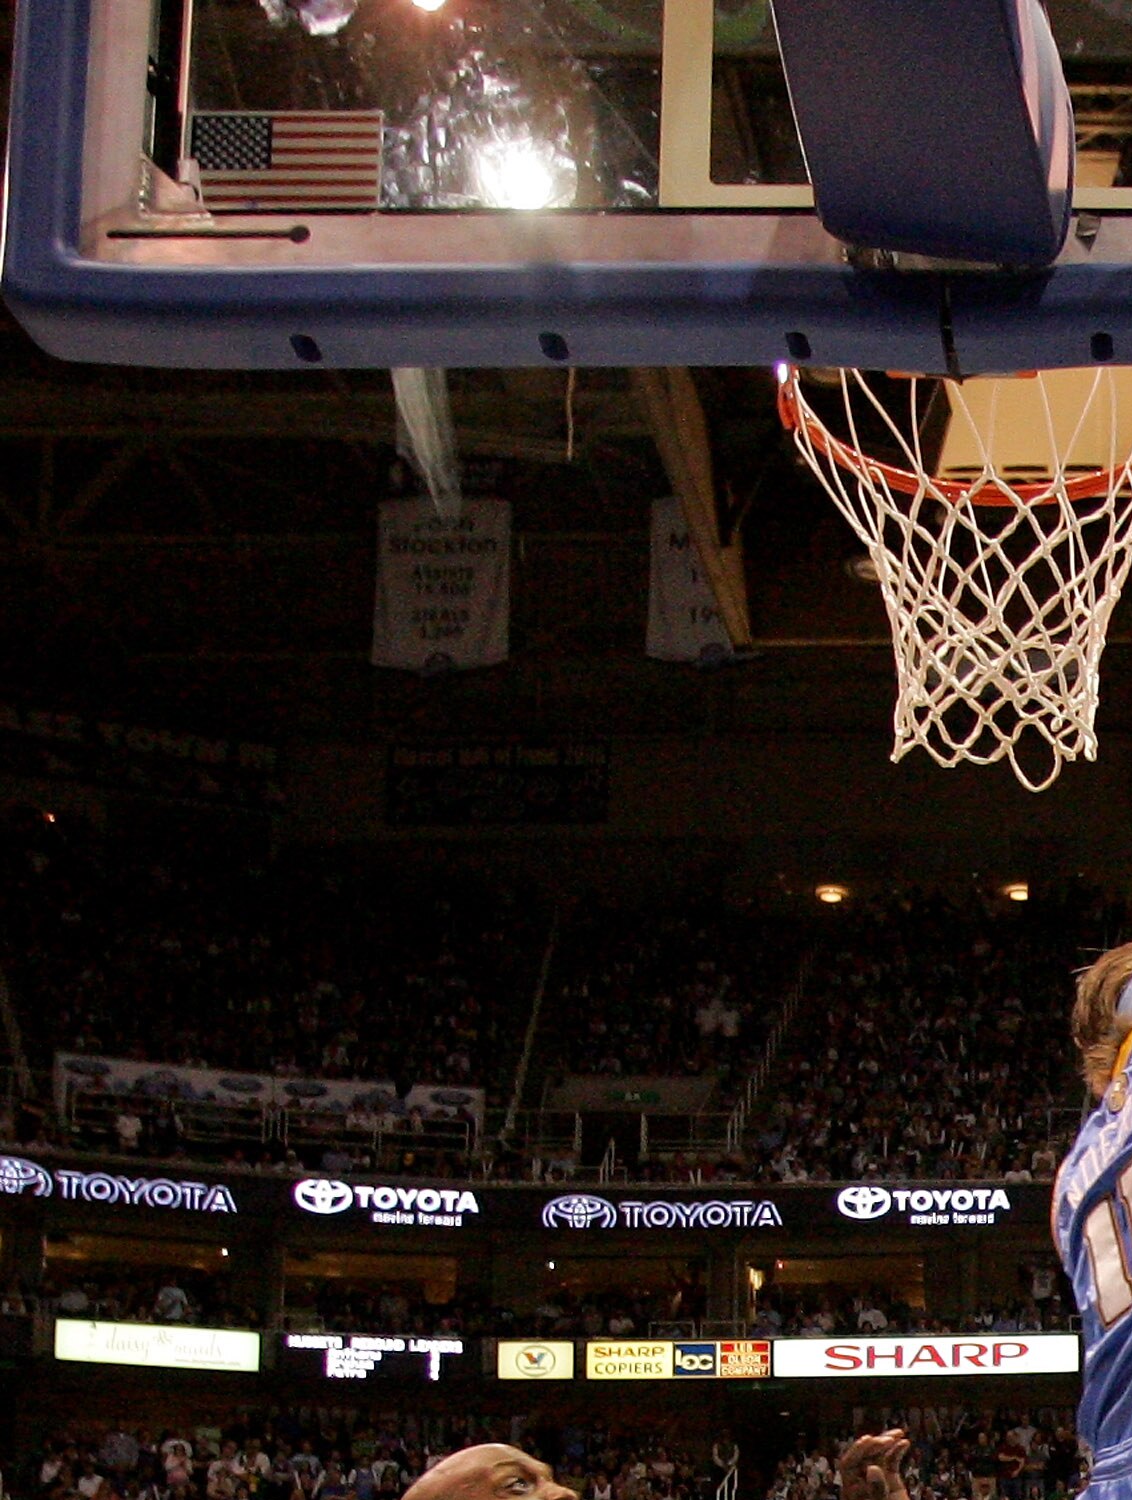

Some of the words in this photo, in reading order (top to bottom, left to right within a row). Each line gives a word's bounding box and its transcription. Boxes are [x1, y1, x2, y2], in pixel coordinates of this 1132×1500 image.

[55, 1169, 238, 1214] TOYOTA
[354, 1185, 479, 1213] TOYOTA
[892, 1188, 1012, 1212] TOYOTA
[618, 1200, 784, 1228] TOYOTA
[593, 1346, 665, 1358] SHARP
[824, 1342, 1030, 1371] SHARP
[594, 1362, 663, 1375] COPIERS
